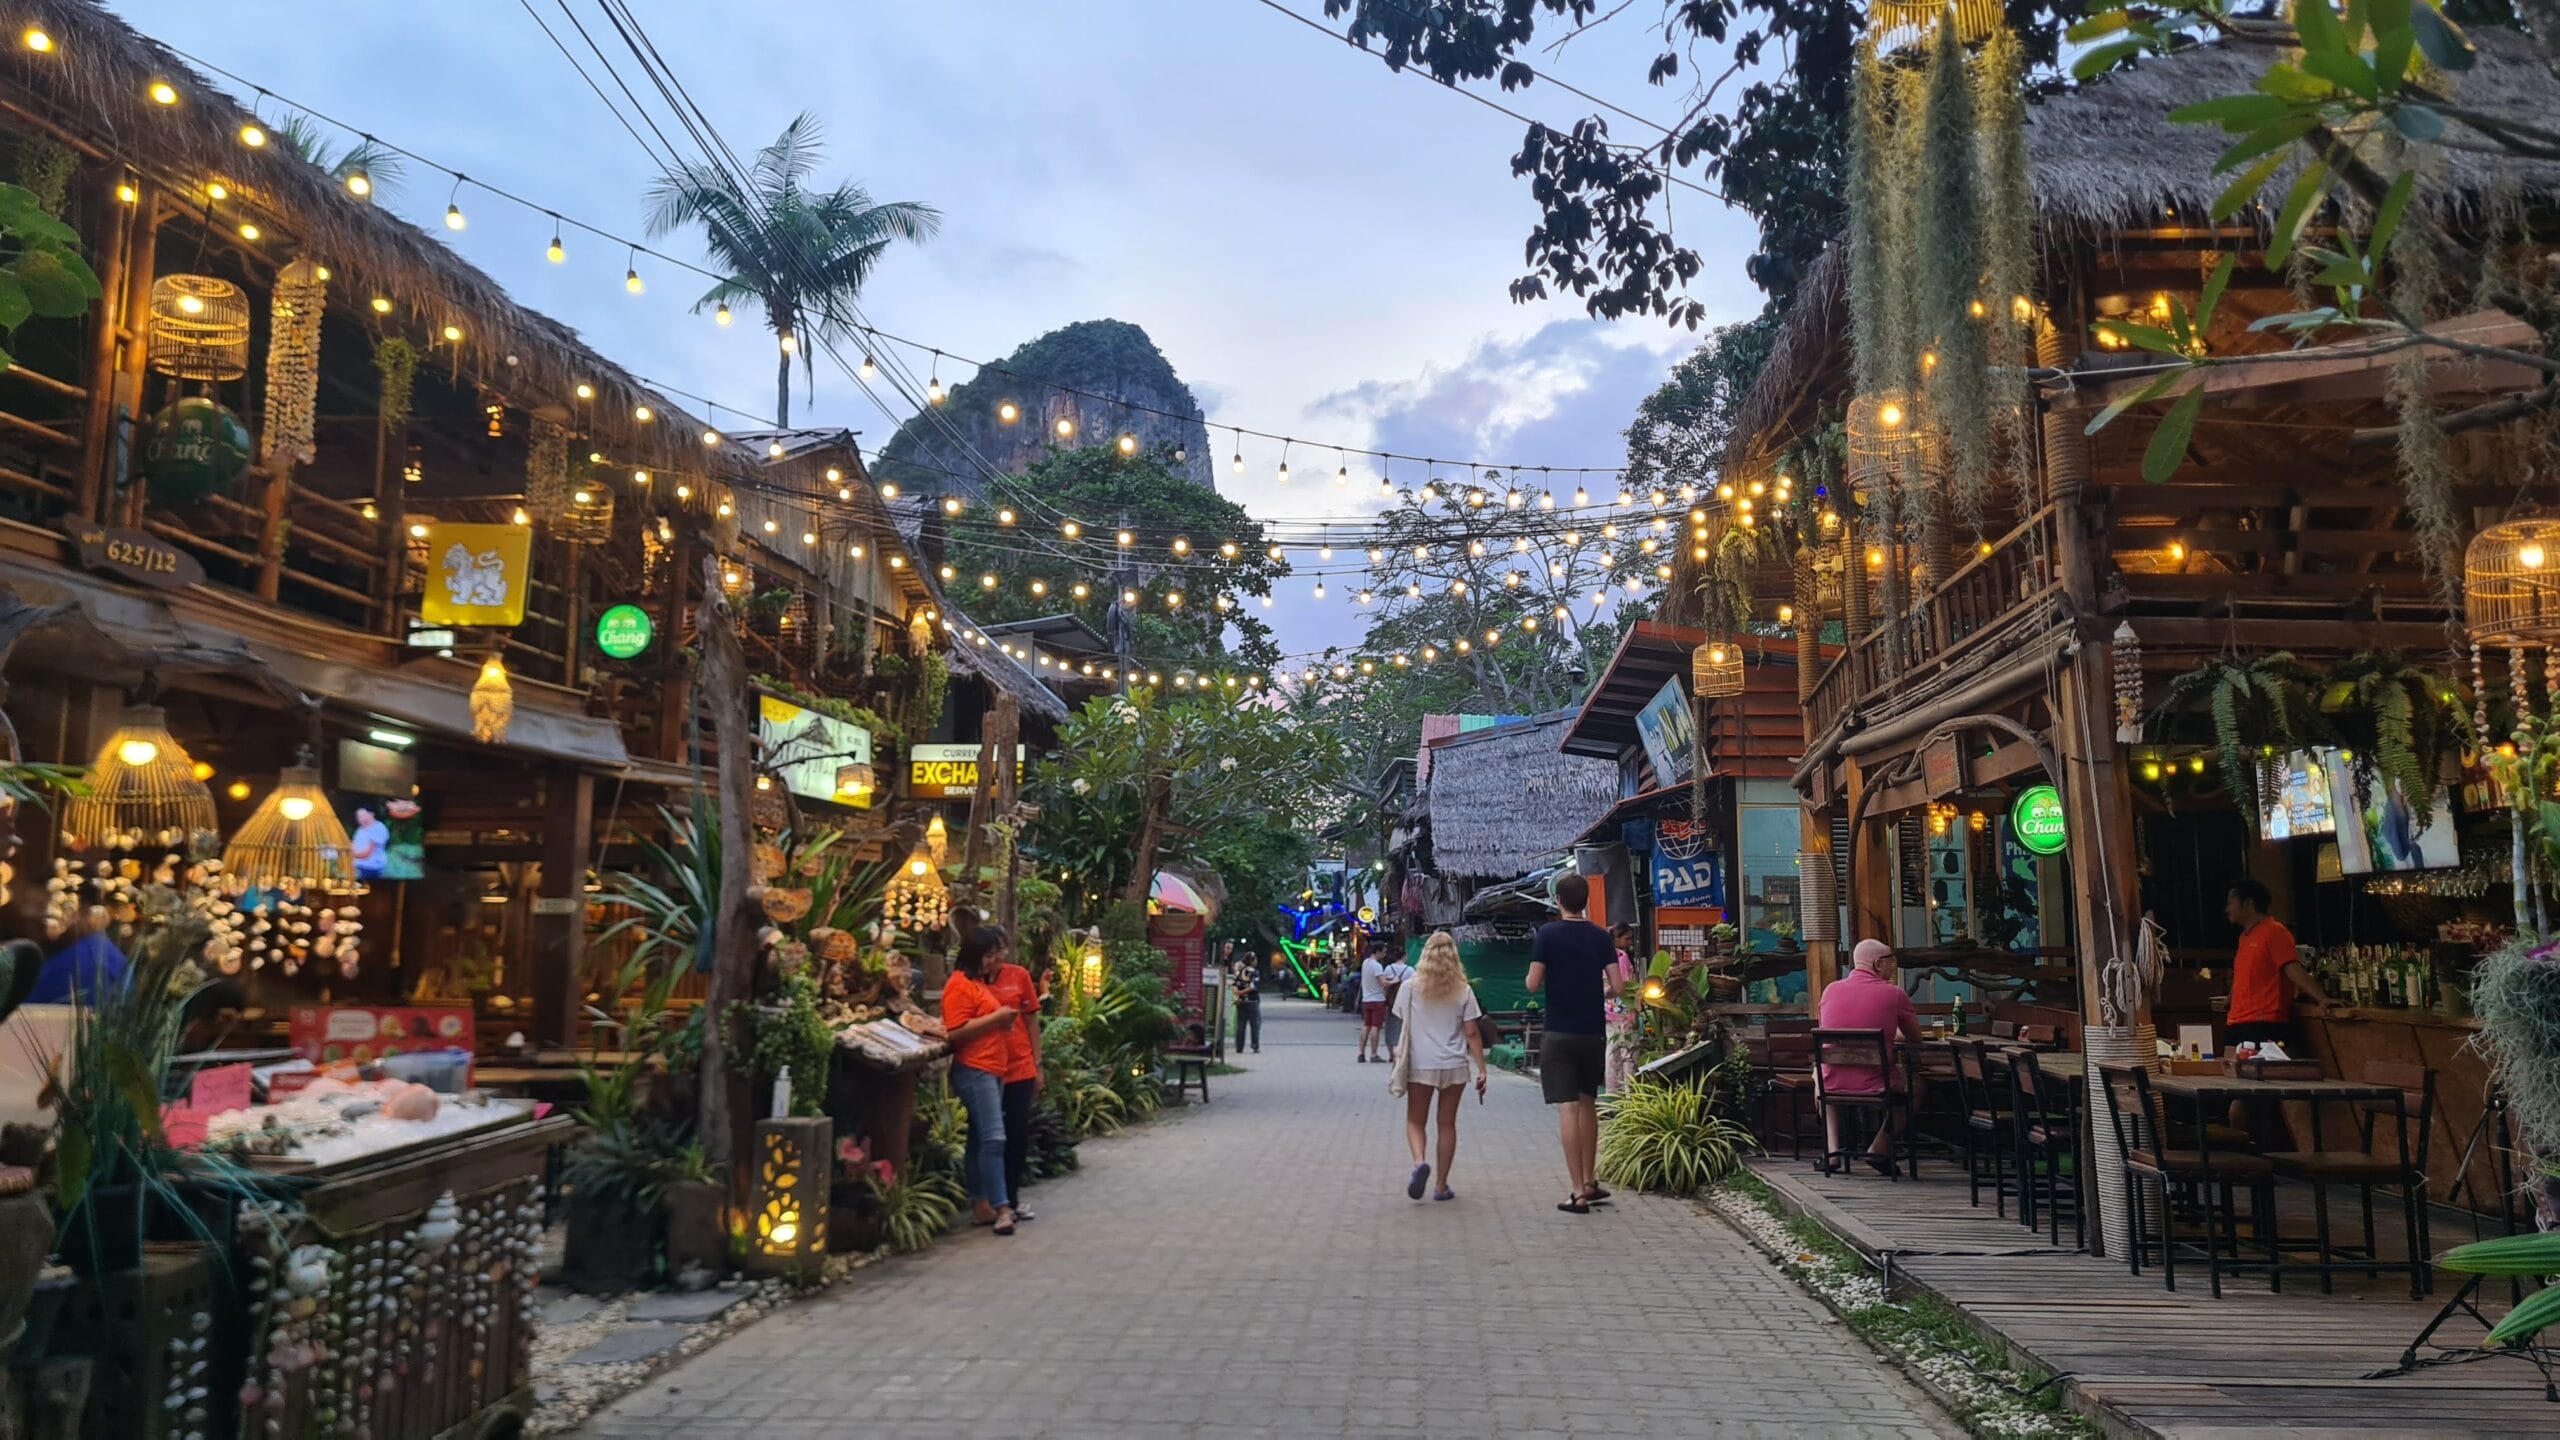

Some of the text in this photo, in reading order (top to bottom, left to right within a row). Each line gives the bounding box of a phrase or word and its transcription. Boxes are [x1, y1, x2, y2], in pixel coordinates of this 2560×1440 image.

[107, 540, 176, 572] 625/12
[600, 629, 647, 647] Chang
[2022, 820, 2065, 837] Chan
